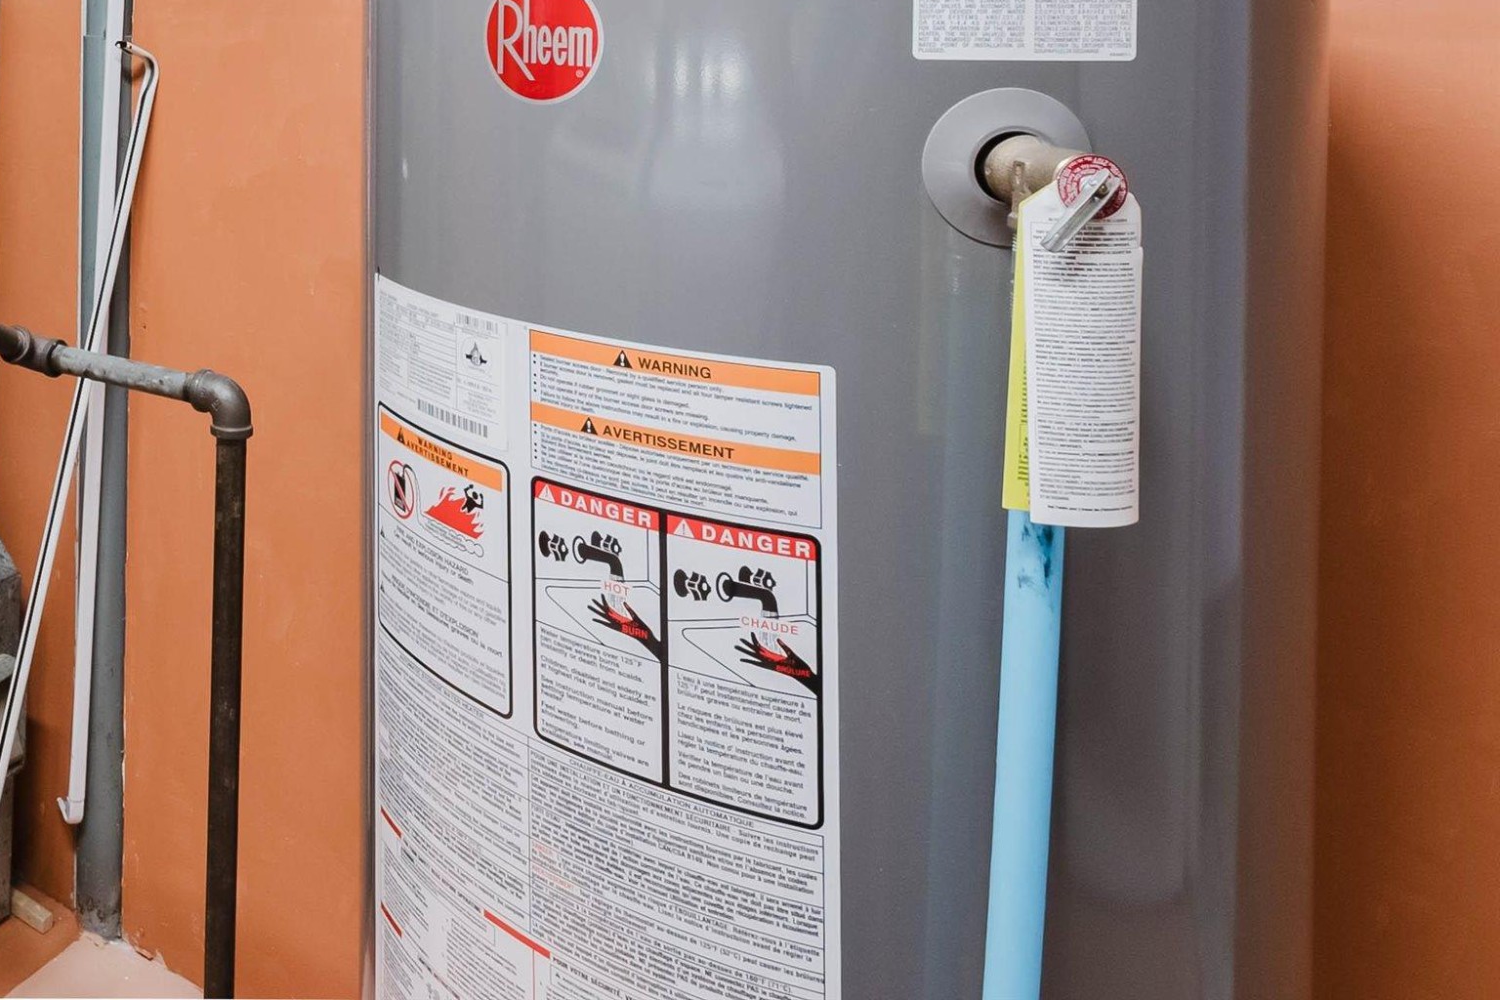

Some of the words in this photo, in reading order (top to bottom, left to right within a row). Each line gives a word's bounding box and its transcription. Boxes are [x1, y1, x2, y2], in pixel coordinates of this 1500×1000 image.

[638, 357, 710, 378] WARNING
[417, 436, 453, 460] WARNING
[602, 424, 734, 459] AVERTISSEMENT
[560, 490, 651, 527] DANGER
[701, 524, 811, 558] DANGER
[604, 582, 629, 597] HOT
[621, 624, 648, 639] BURN
[741, 616, 798, 635] CHAUDE
